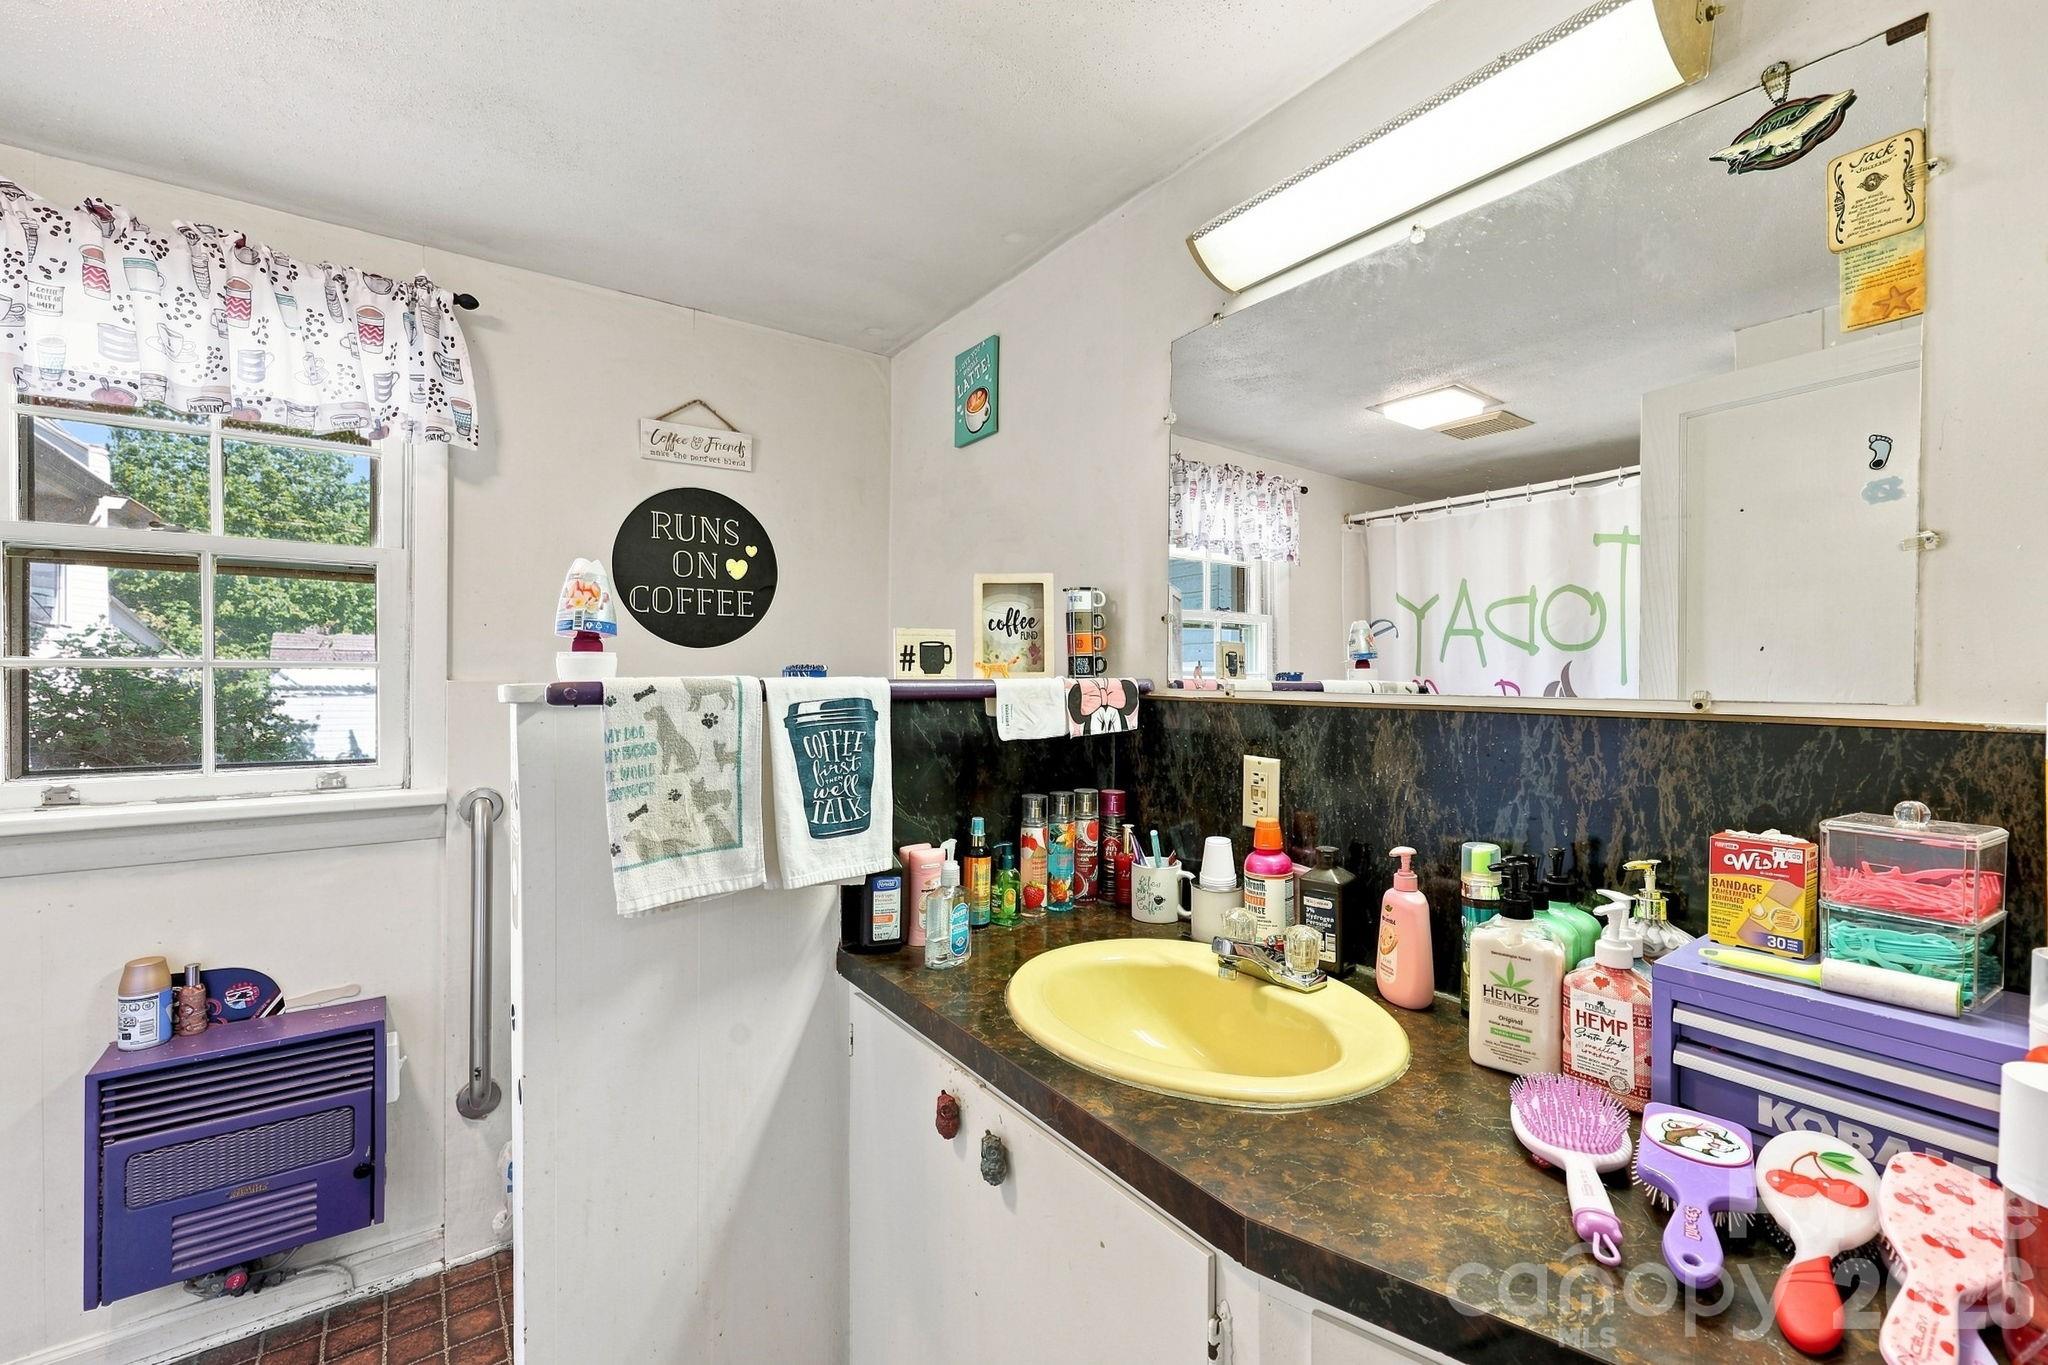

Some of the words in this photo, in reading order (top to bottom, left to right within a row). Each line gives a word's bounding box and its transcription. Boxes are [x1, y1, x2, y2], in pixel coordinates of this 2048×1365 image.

[1849, 139, 1897, 168] Jack
[957, 353, 990, 398] LATTE!
[650, 429, 688, 452] Coffee
[704, 437, 746, 458] Friends
[690, 454, 721, 464] perfect
[724, 459, 746, 467] blend
[651, 511, 740, 546] RUNS
[672, 550, 718, 580] ON
[629, 585, 754, 618] COFFEE
[988, 607, 1040, 638] coffee
[1020, 631, 1038, 640] FUND
[803, 728, 867, 763] COFFEE
[812, 755, 862, 787] first
[826, 775, 843, 784] THEN
[811, 796, 870, 824] TALK
[1723, 852, 1789, 871] Wish
[1712, 877, 1763, 895] BANDAGE
[1305, 912, 1335, 923] Hydrogen
[1767, 936, 1787, 949] 30
[1483, 984, 1540, 1007] HEMPZ
[1498, 1015, 1524, 1026] Original
[1576, 1010, 1628, 1037] HEMP
[1574, 1027, 1603, 1042] Santa
[1606, 1036, 1630, 1053] Baby
